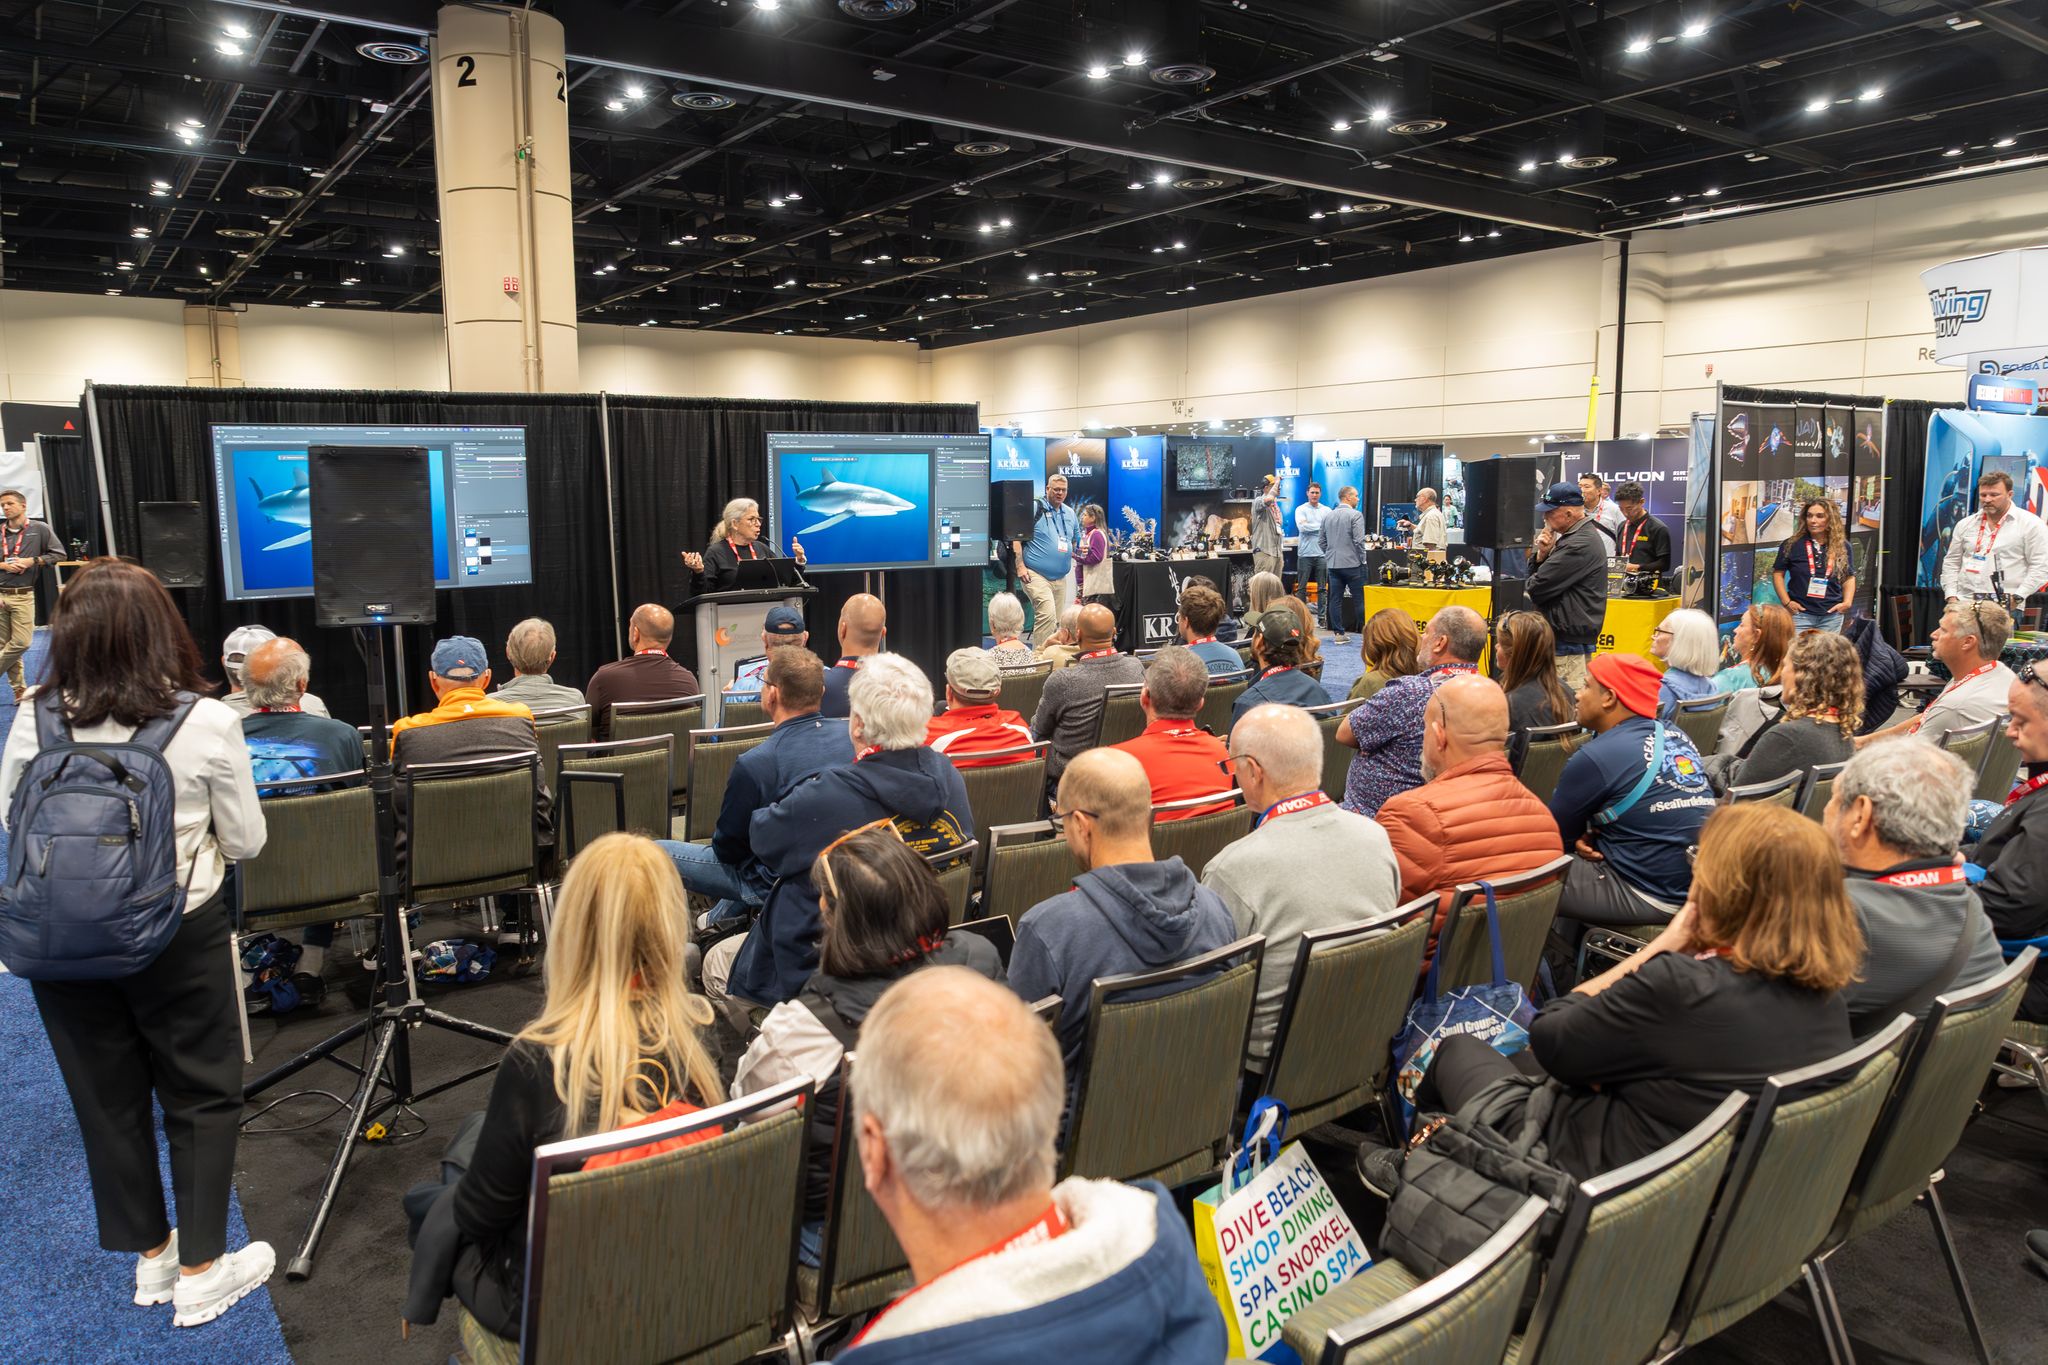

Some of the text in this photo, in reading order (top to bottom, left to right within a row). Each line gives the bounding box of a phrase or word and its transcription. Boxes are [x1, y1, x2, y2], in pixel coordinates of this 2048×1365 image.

[456, 55, 477, 88] 2
[1931, 293, 1985, 319] iving
[2038, 388, 2048, 402] N
[997, 460, 1029, 469] KRAKEN
[1058, 467, 1092, 476] KRAKEN
[1121, 460, 1149, 469] KRAKEN
[1597, 634, 1615, 646] EA
[1905, 871, 1939, 886] DAN
[1440, 1022, 1464, 1038] Small
[1220, 1159, 1318, 1255] DIVE BEACH
[1229, 1186, 1333, 1286] SHOP DINING
[1240, 1214, 1350, 1317] SPA SNORKEL
[1250, 1240, 1361, 1348] CASINO SPA
